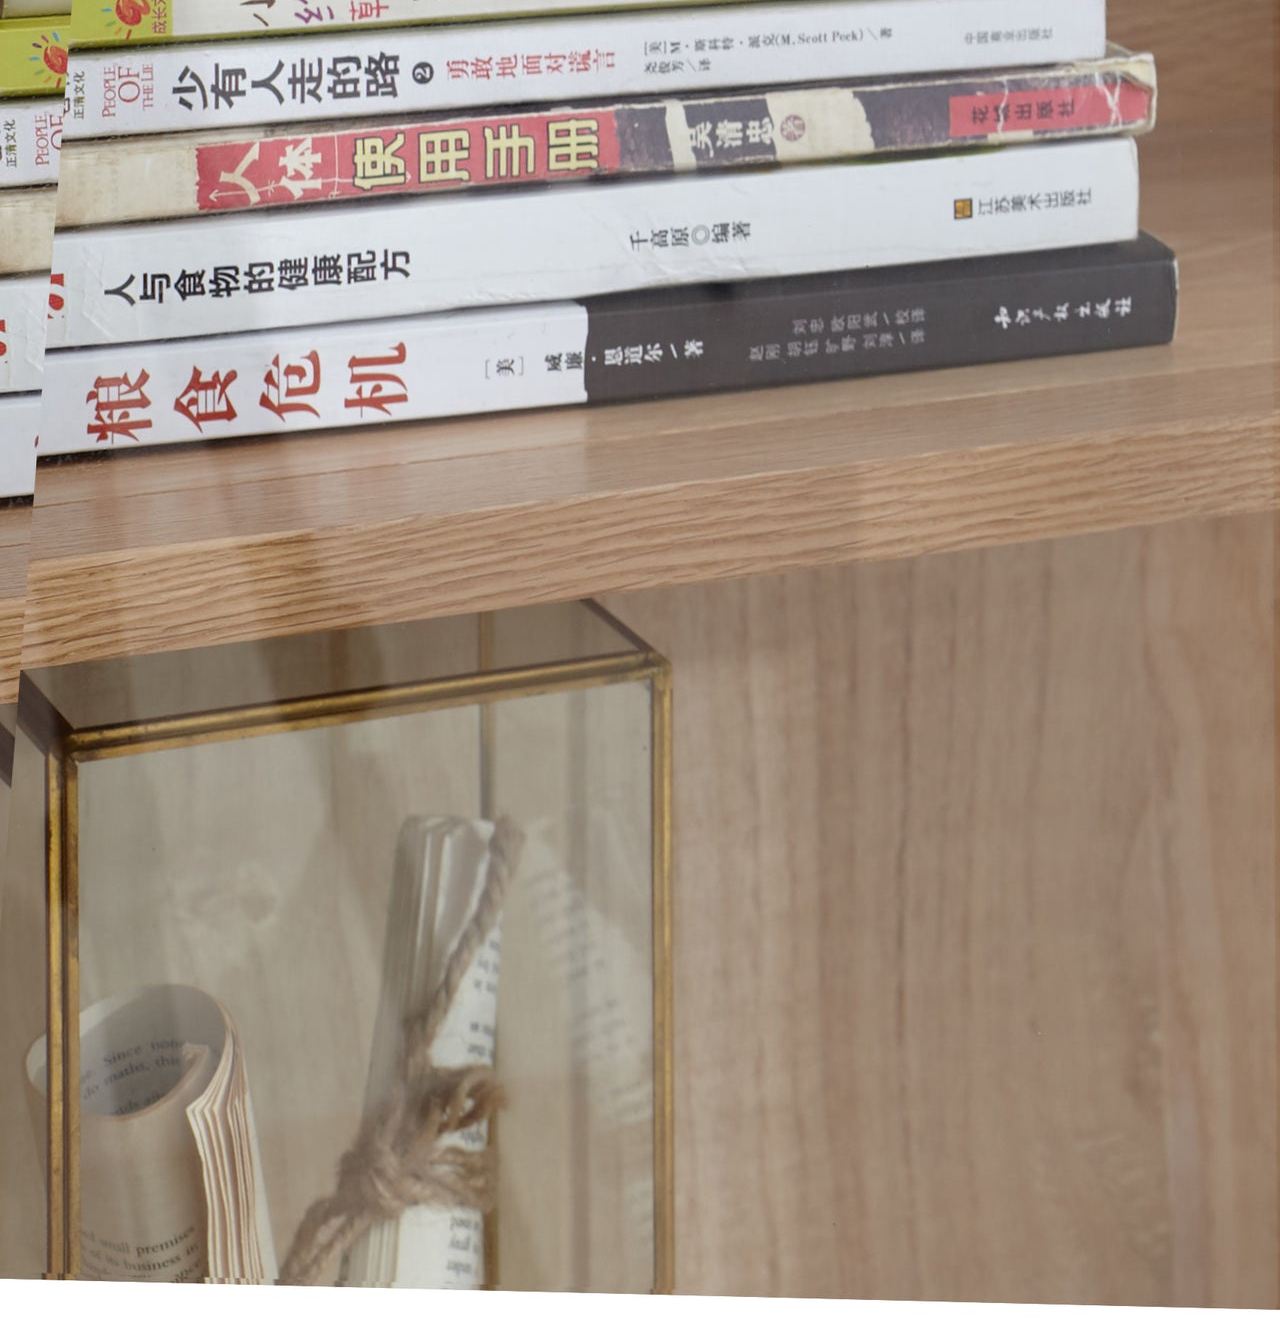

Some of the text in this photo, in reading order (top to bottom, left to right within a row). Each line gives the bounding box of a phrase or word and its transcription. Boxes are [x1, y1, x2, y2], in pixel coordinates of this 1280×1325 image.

[964, 27, 1054, 45] 中国商业出版社
[118, 67, 139, 105] OF
[171, 51, 401, 112] 少有人走的路
[446, 50, 616, 81] 勇敢地面对谎言
[73, 71, 86, 120] 正清文化
[101, 65, 116, 118] PEOPLE
[142, 63, 154, 111] THE LIE
[971, 98, 1075, 125] 花城出版社
[4, 119, 17, 167] 正清文化
[35, 113, 49, 166] PEOPLE
[686, 115, 775, 156] 吴清忠
[217, 117, 600, 205] 人体使用手册
[977, 187, 1093, 216] 江苏美术出版社
[104, 250, 411, 305] 人与食物的健康配方
[994, 296, 1133, 330] 知识产权出版社
[86, 341, 409, 443] 粮食危机
[103, 1045, 142, 1066] Since
[135, 1226, 195, 1258] premises
[123, 1255, 182, 1271] business
